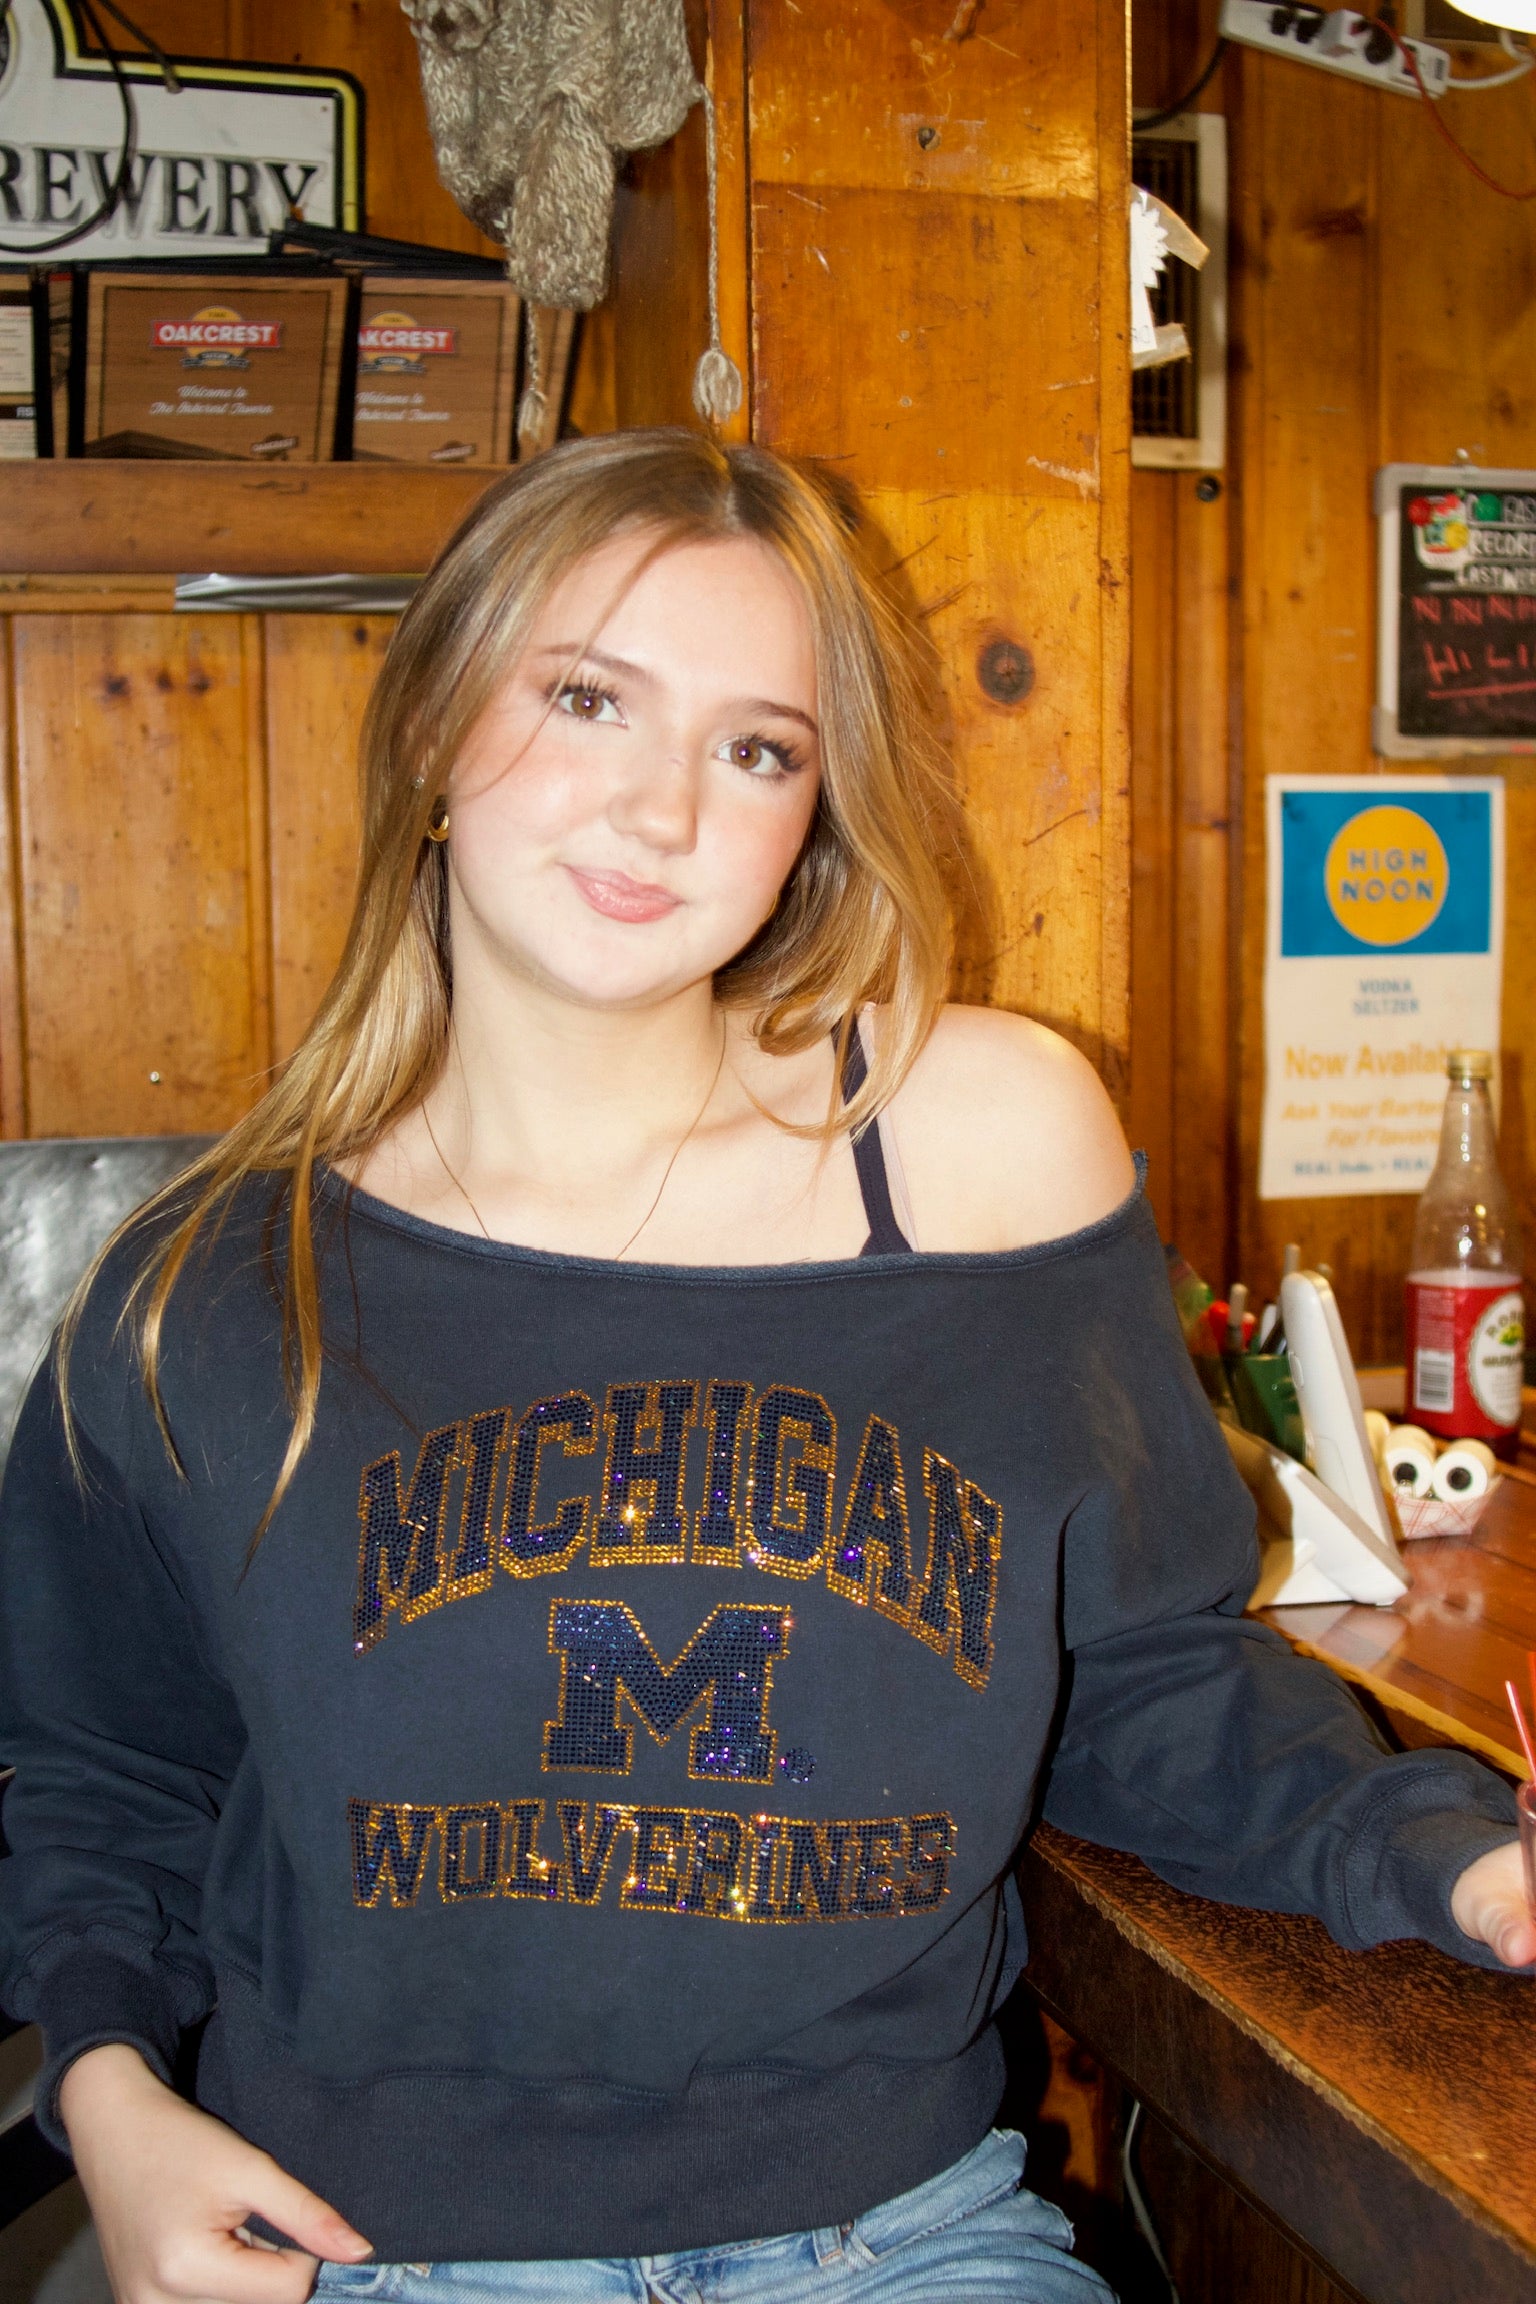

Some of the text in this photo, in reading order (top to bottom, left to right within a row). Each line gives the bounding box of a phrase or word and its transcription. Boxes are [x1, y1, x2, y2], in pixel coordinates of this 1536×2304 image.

[160, 324, 273, 342] OAKCREST
[1347, 847, 1428, 873] HIGH
[1340, 877, 1433, 903] NOON
[1286, 1045, 1346, 1081] Now
[353, 1379, 1003, 1694] MICHIGAN
[347, 1797, 958, 1926] WOLVERINES
